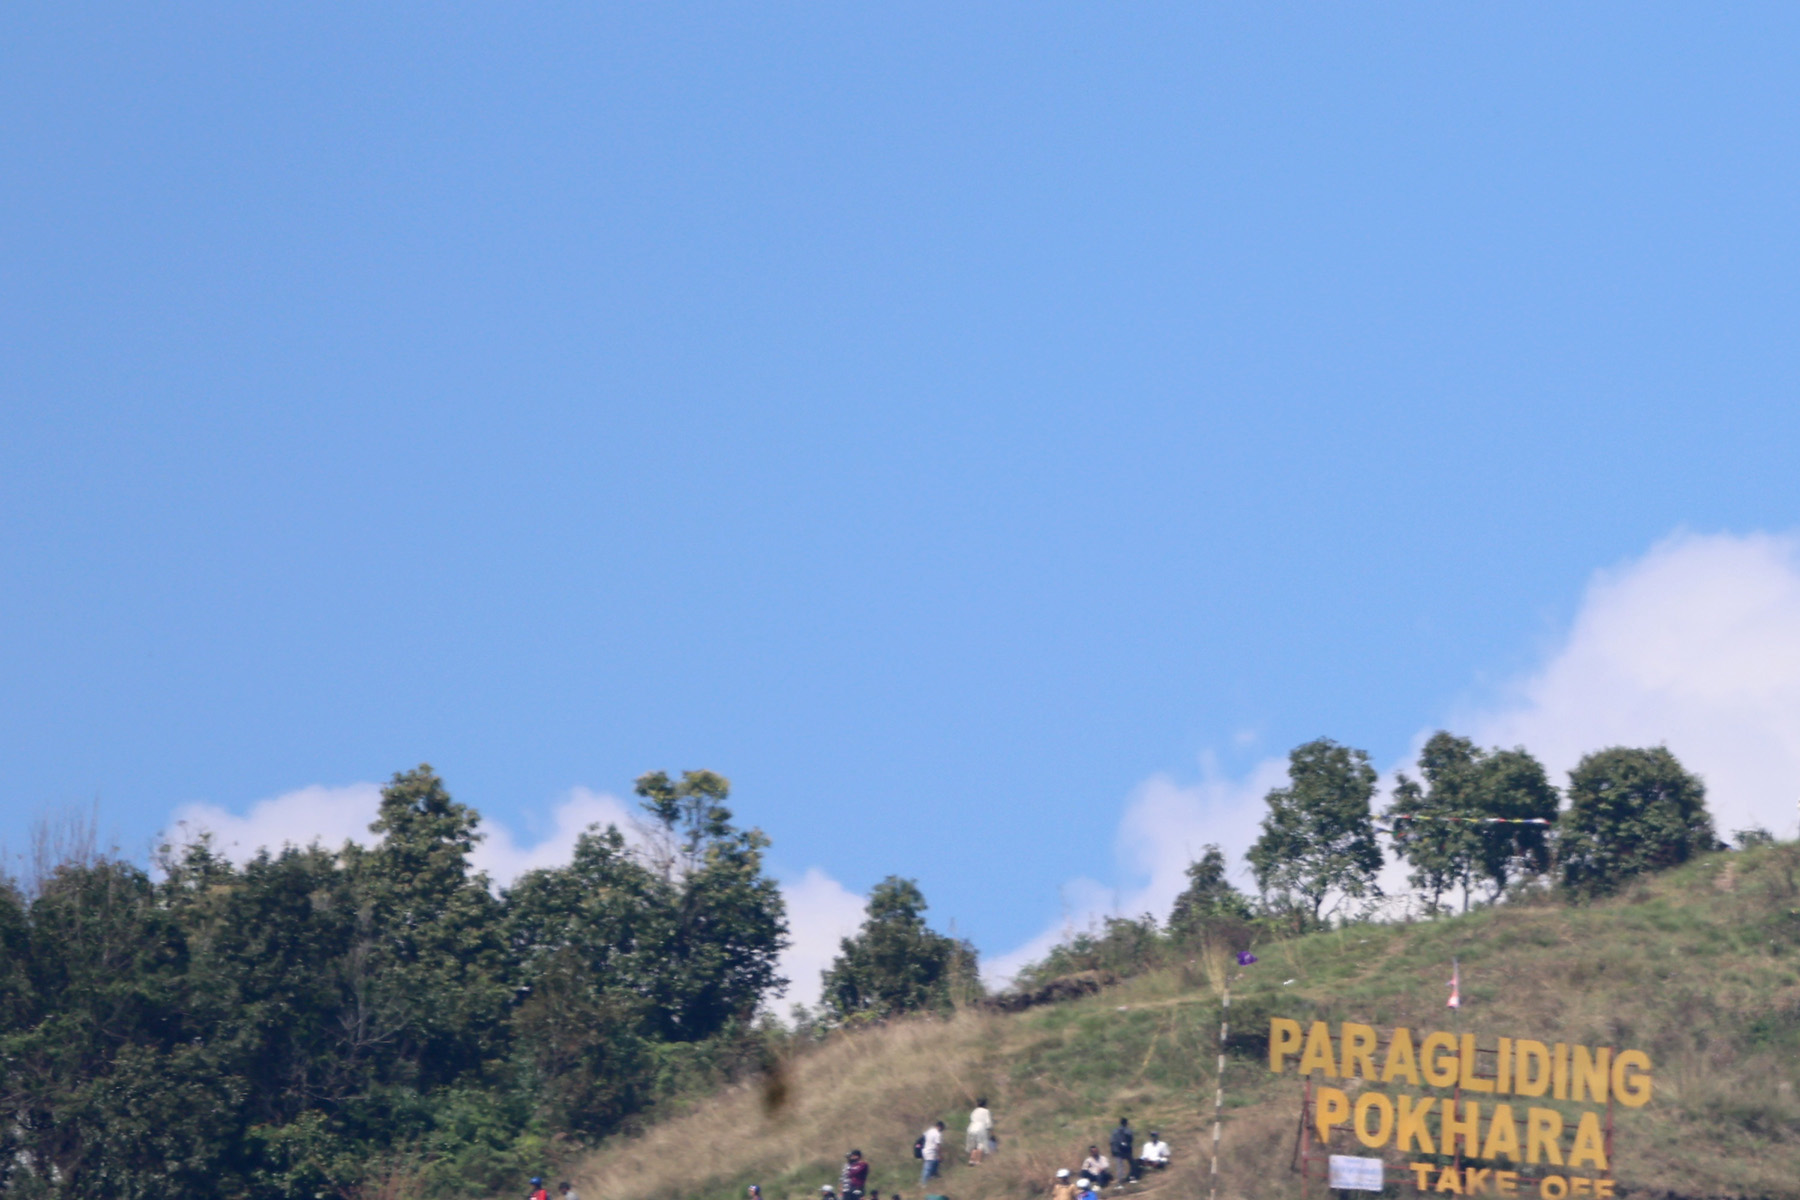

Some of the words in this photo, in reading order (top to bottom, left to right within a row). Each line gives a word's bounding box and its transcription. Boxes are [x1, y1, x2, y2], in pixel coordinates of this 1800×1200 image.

[1268, 1017, 1653, 1108] PARAGLIDING
[1315, 1086, 1608, 1170] POKHARA
[1409, 1162, 1520, 1198] TAKE
